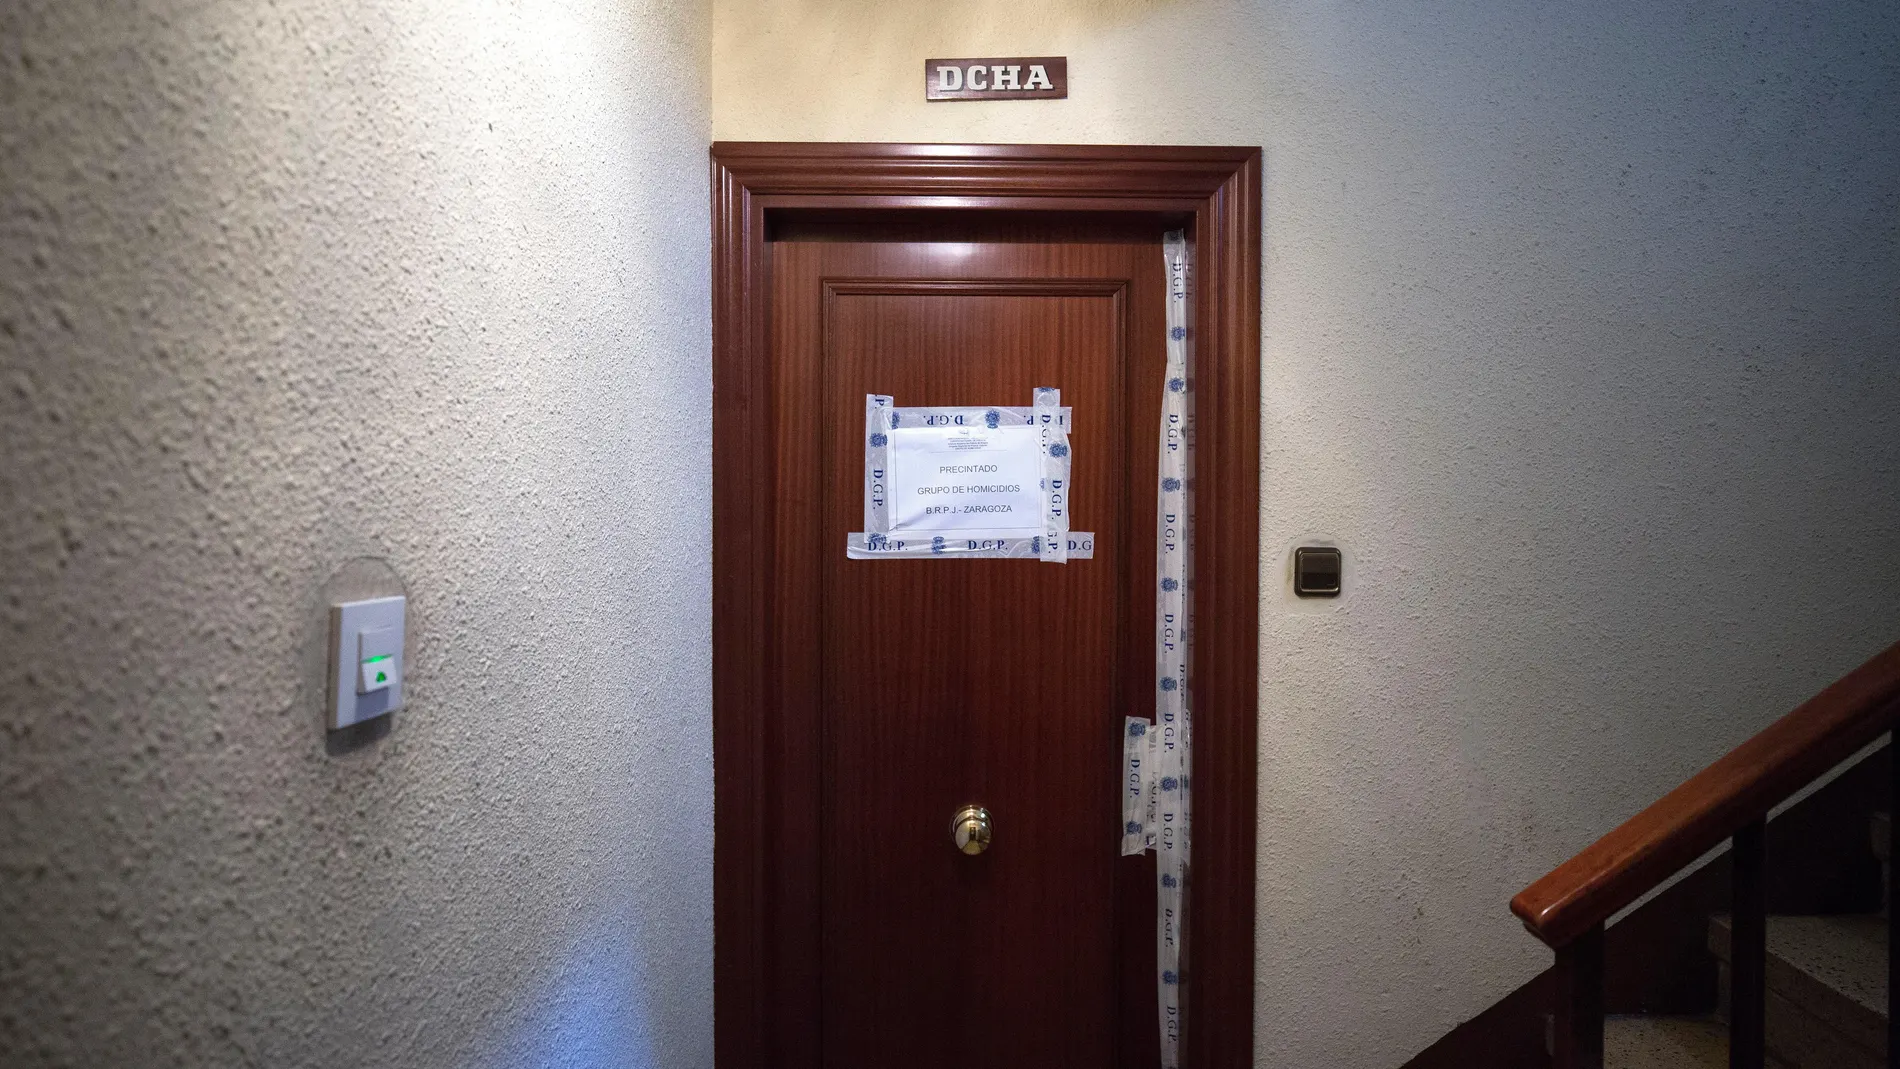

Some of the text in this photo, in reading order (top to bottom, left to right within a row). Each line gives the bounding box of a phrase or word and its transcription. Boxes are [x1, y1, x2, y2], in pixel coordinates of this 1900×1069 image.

[936, 65, 1054, 91] DCHA
[1172, 263, 1184, 303] D.G.P.
[923, 414, 965, 426] D.G.P.
[1167, 414, 1179, 454] D.G.P.
[939, 464, 998, 474] PRECINTADO
[873, 469, 884, 510] D.G.P.
[917, 484, 1021, 495] GRUPO DE HOMICIDIOS
[1051, 479, 1063, 520] D.G.P.
[963, 504, 1013, 514] ZARAGOZA
[868, 541, 908, 551] D.G.P.
[968, 540, 1008, 551] D.G.P.
[1165, 514, 1176, 554] D.G.P.
[1164, 613, 1174, 654] D.G.P.
[1164, 713, 1175, 753] D.G.P.
[1129, 759, 1140, 798] D.G.P.
[1163, 813, 1174, 851] D.G.P.
